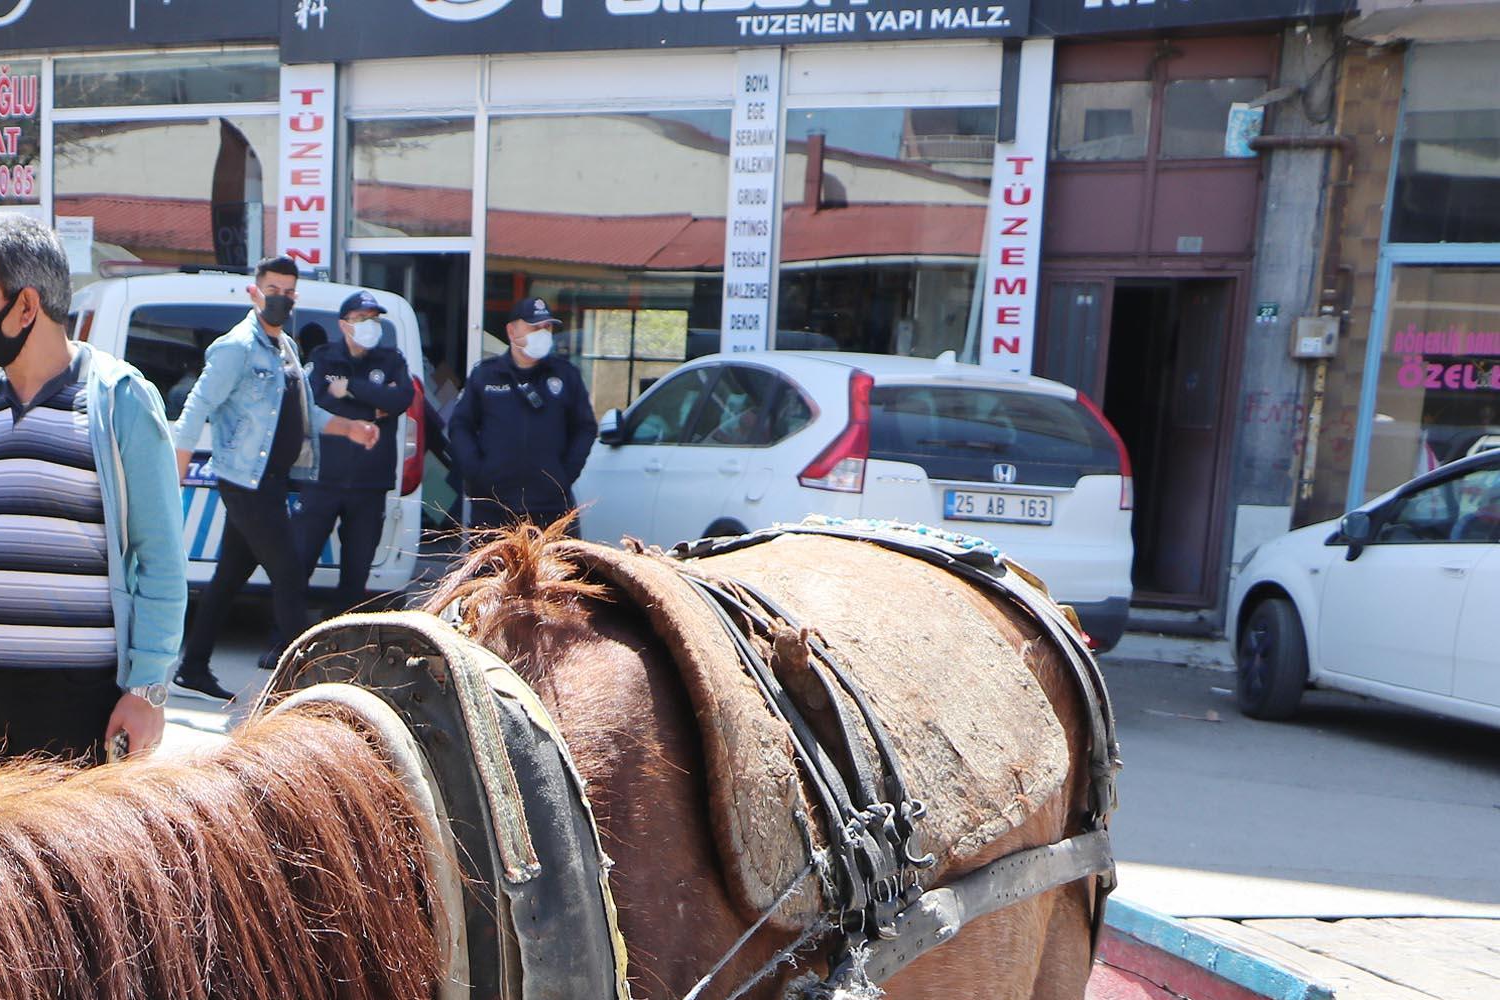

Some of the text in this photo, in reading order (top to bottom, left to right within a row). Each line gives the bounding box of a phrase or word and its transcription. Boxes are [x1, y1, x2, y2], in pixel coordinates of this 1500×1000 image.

[736, 5, 1011, 36] TÜZEMEN YAPI MALZ.
[745, 74, 770, 93] BOYA
[735, 125, 775, 147] SERAMİK
[12, 165, 35, 197] 85
[284, 88, 325, 265] TÜZEMEN
[737, 187, 769, 206] GRUBU
[731, 247, 767, 268] TESİSAT
[992, 156, 1034, 354] TÜZEMEN
[730, 313, 760, 331] DEKOR
[1397, 354, 1477, 390] ÖZEL
[956, 495, 1048, 518] 25 AB 163
